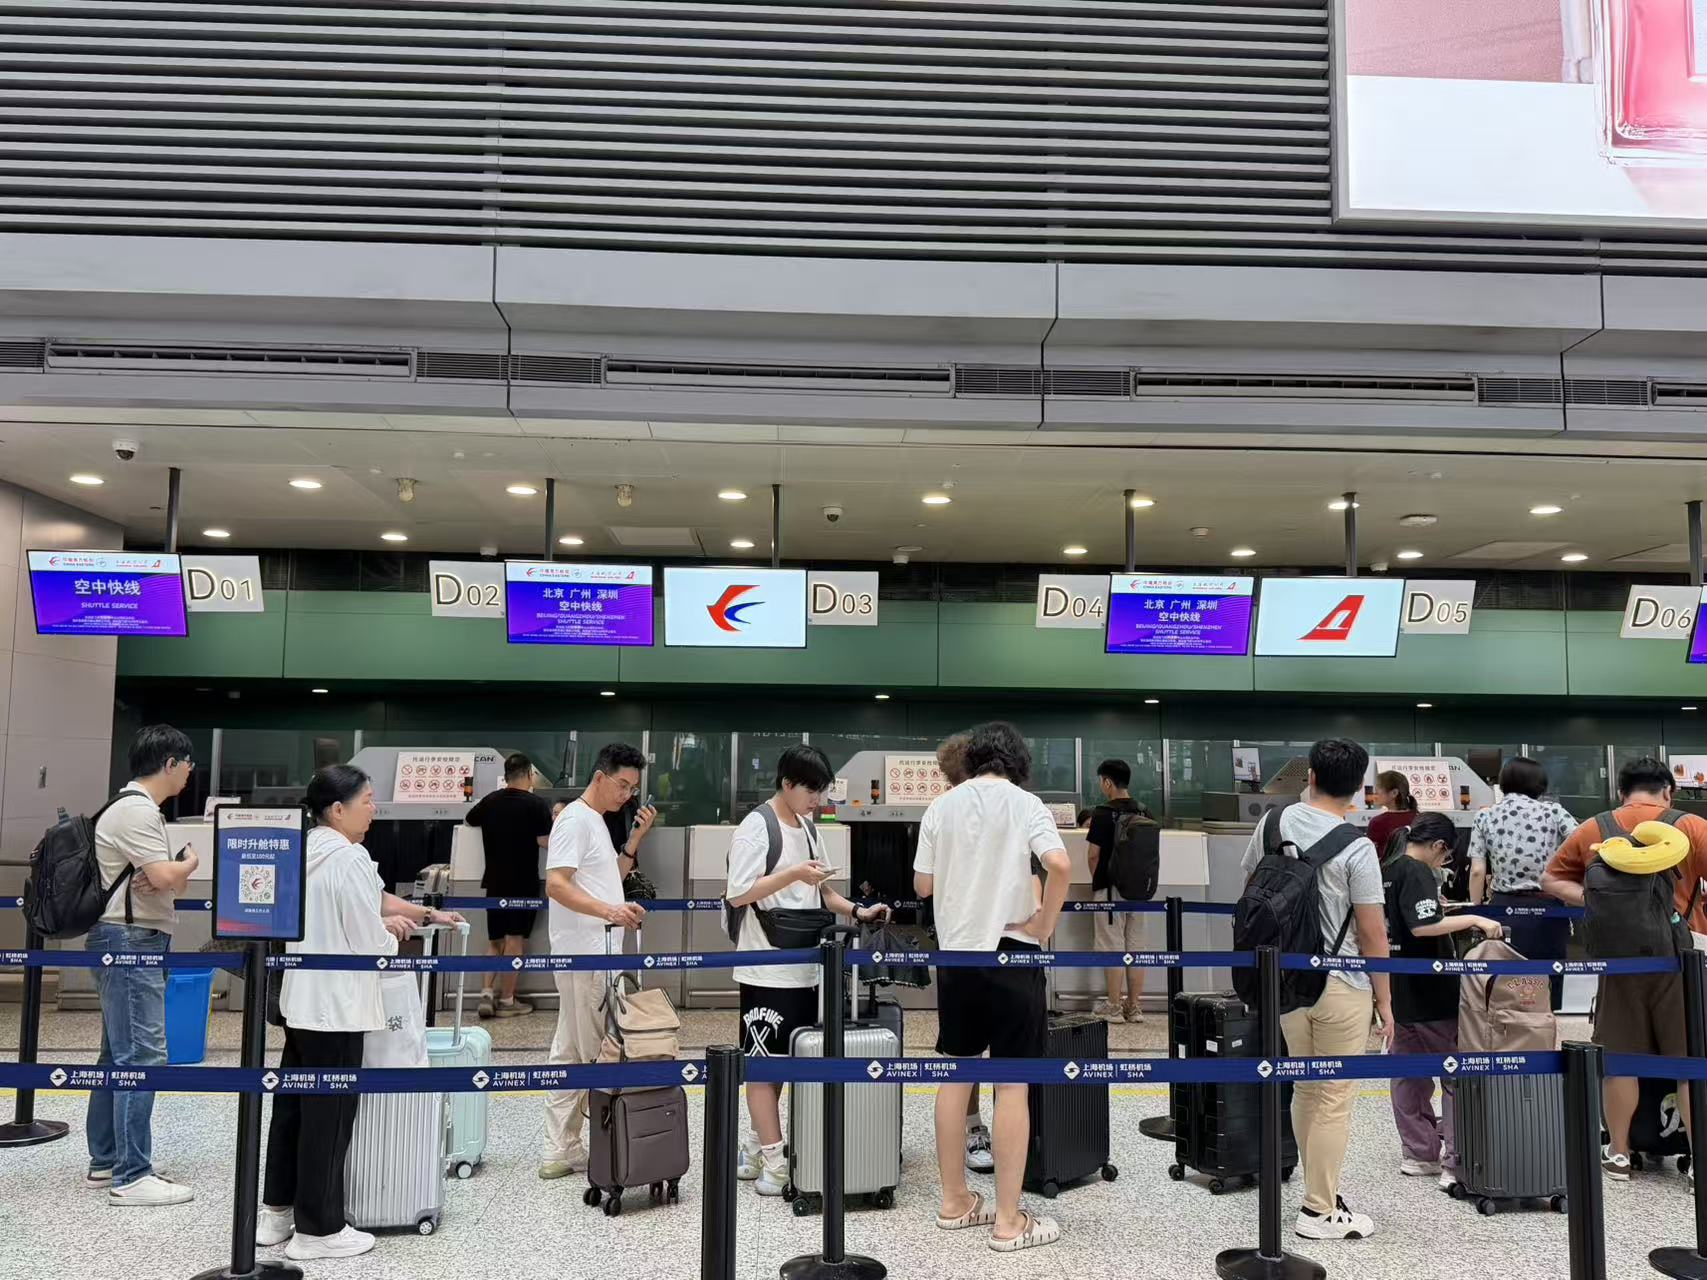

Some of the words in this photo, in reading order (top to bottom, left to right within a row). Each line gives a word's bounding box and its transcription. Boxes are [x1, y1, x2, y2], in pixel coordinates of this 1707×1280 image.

[74, 578, 141, 595] 空中快线
[187, 569, 251, 600] D01
[435, 574, 500, 606] D02
[543, 588, 564, 599] 北京
[570, 588, 591, 599] 广州
[597, 589, 618, 599] 深圳
[812, 584, 872, 614] D03
[560, 601, 602, 611] 空中快线
[1043, 587, 1104, 618] D04
[1144, 599, 1165, 609] 北京
[1170, 600, 1190, 610] 广州
[1197, 600, 1218, 610] 深圳
[1408, 592, 1468, 622] D05
[1158, 611, 1200, 622] 空中快线
[1631, 598, 1691, 628] D06
[227, 838, 290, 850] 限时升舱特惠
[70, 1070, 104, 1078] 上海机场
[323, 1074, 357, 1082] 虹桥机场
[533, 1070, 567, 1079] 虹桥机场
